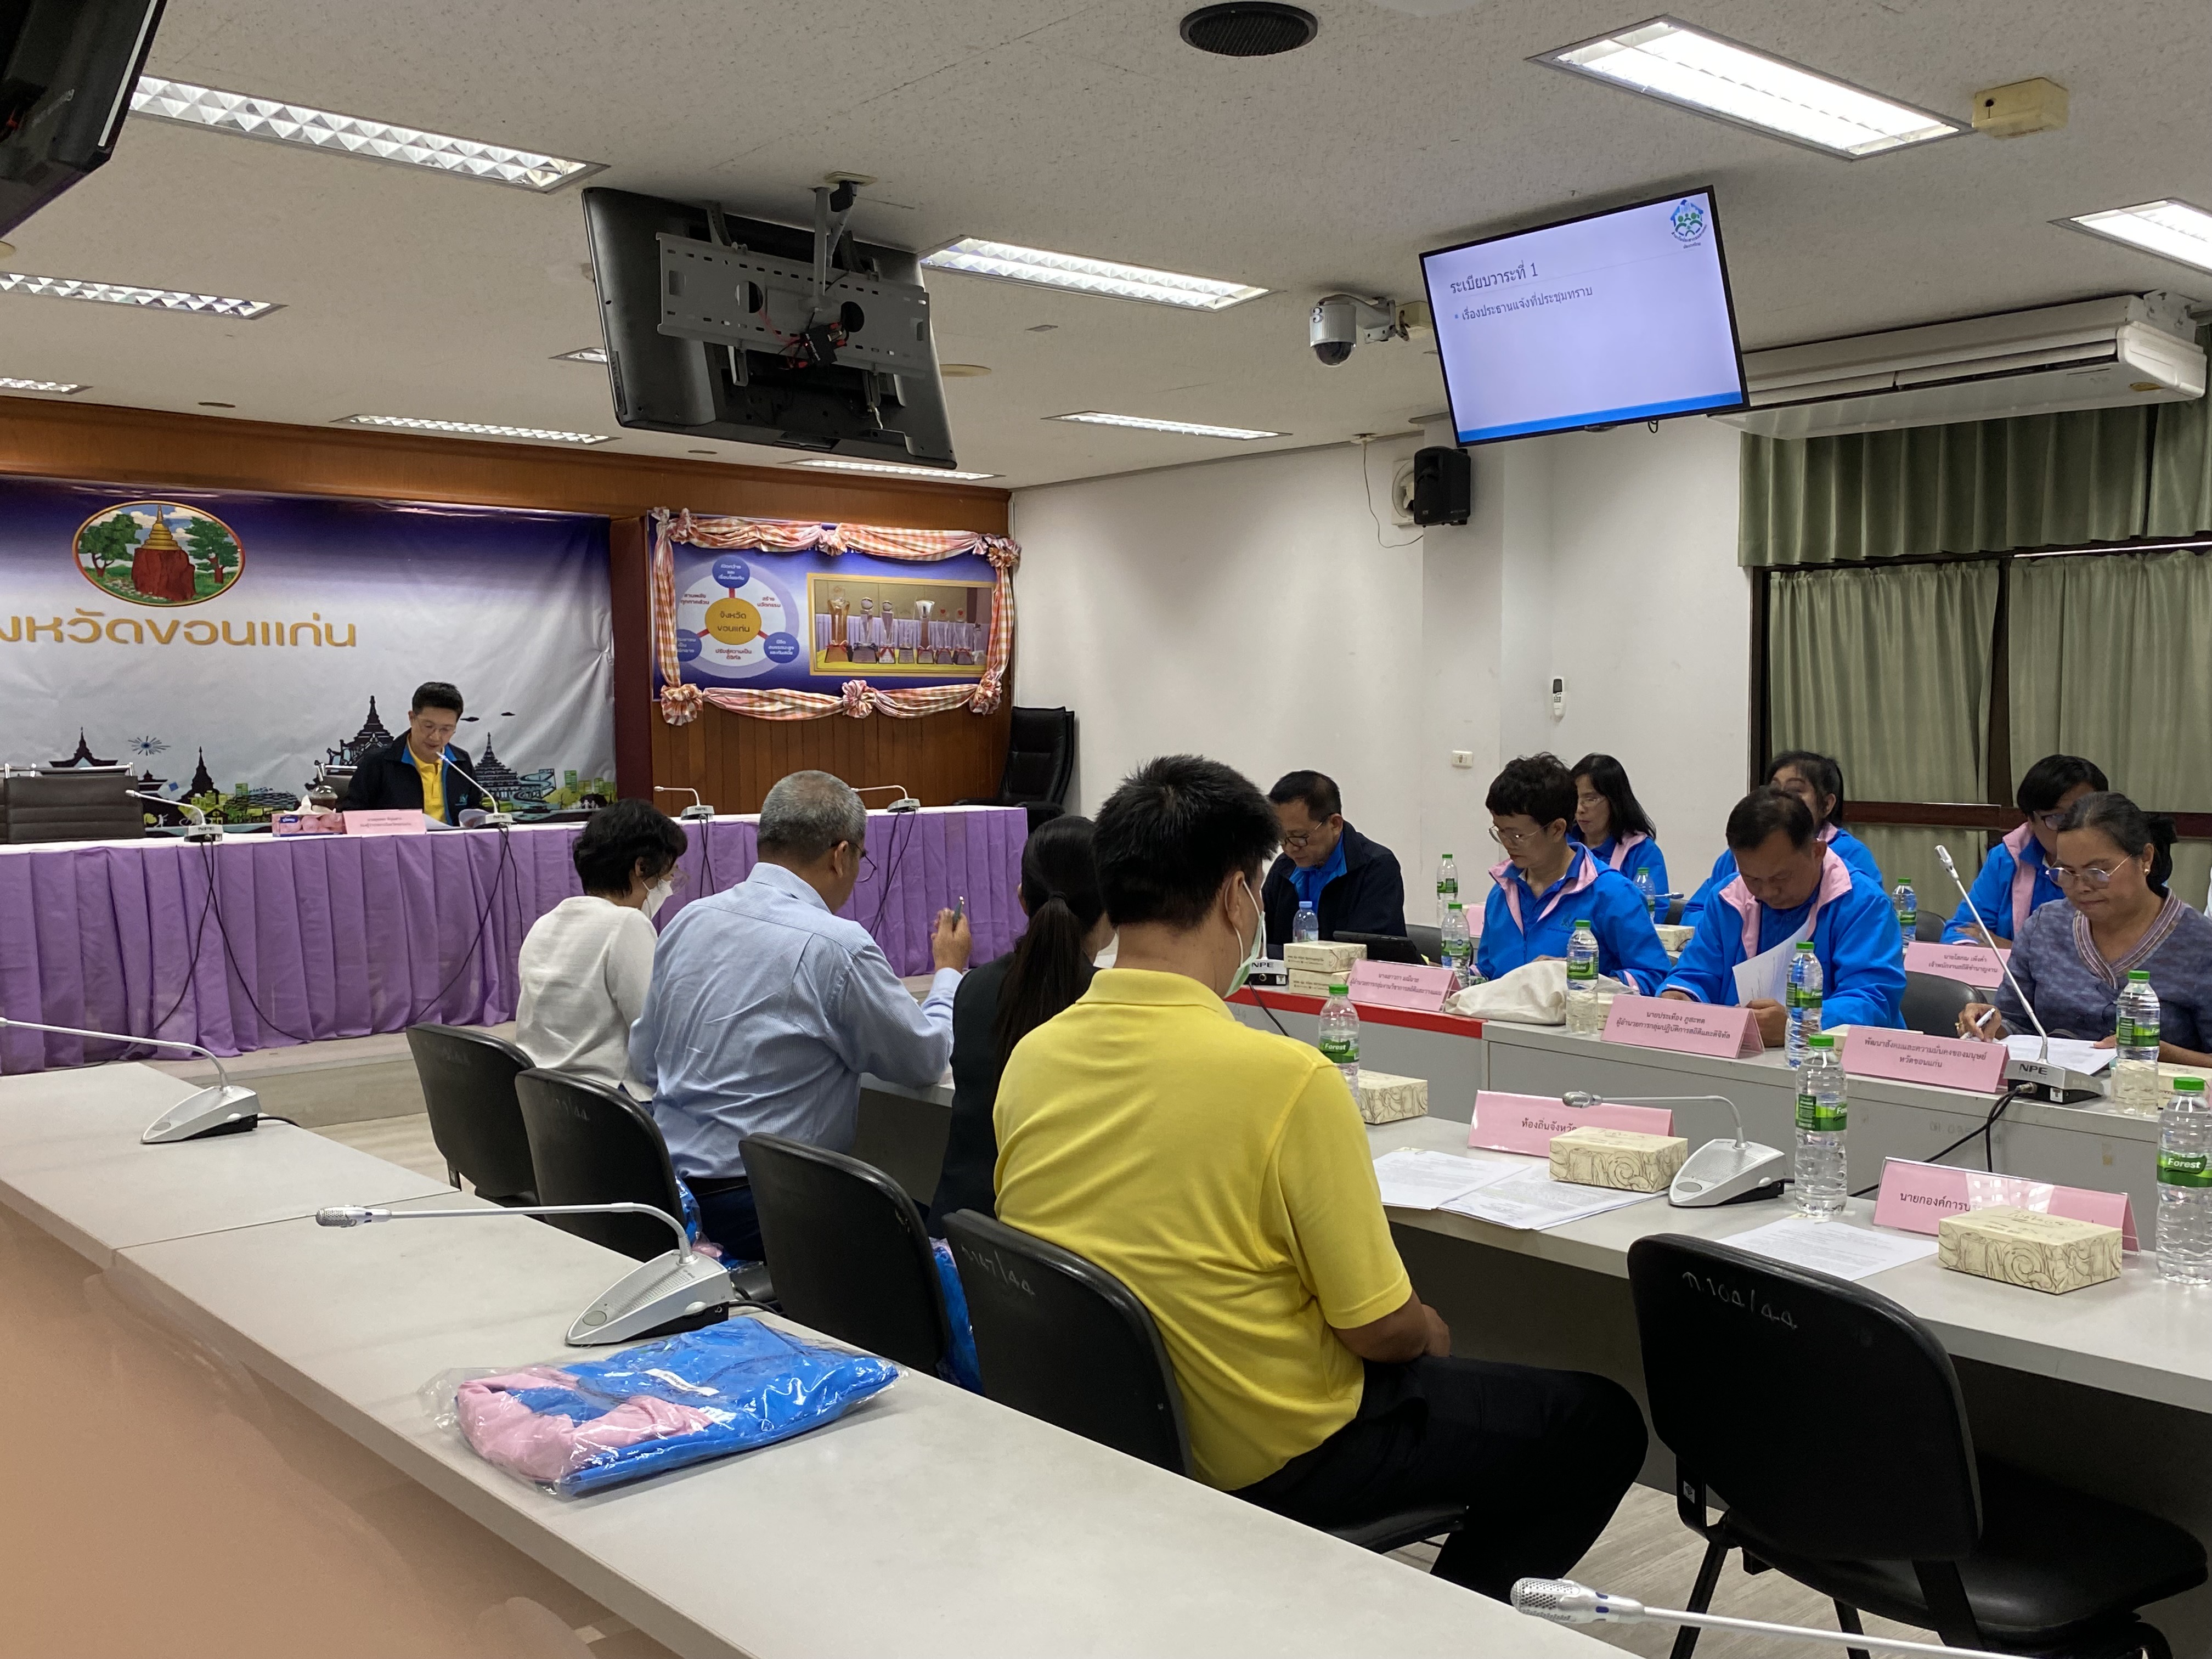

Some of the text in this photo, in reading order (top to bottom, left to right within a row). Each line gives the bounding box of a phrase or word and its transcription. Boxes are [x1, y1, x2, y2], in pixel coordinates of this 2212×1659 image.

[1450, 259, 1538, 294] ระเบียบวาระที่ 1
[1462, 286, 1593, 320] เรื่องประธานแจ้งที่ประชุมทราบ
[720, 611, 747, 619] จังหวัด
[717, 624, 750, 633] ขอนแก่น
[1646, 1011, 1682, 1021] นายประเทือง
[1617, 1018, 1730, 1039] ผู้อำนวยการกลุ่มปฏิบัติการสถิติและดิจิทัล
[1865, 1037, 1988, 1061] พัฒนาสังคมและความมั่นคงของมนุษย์
[2019, 1064, 2048, 1075] NPE
[2168, 1158, 2201, 1169] Forest
